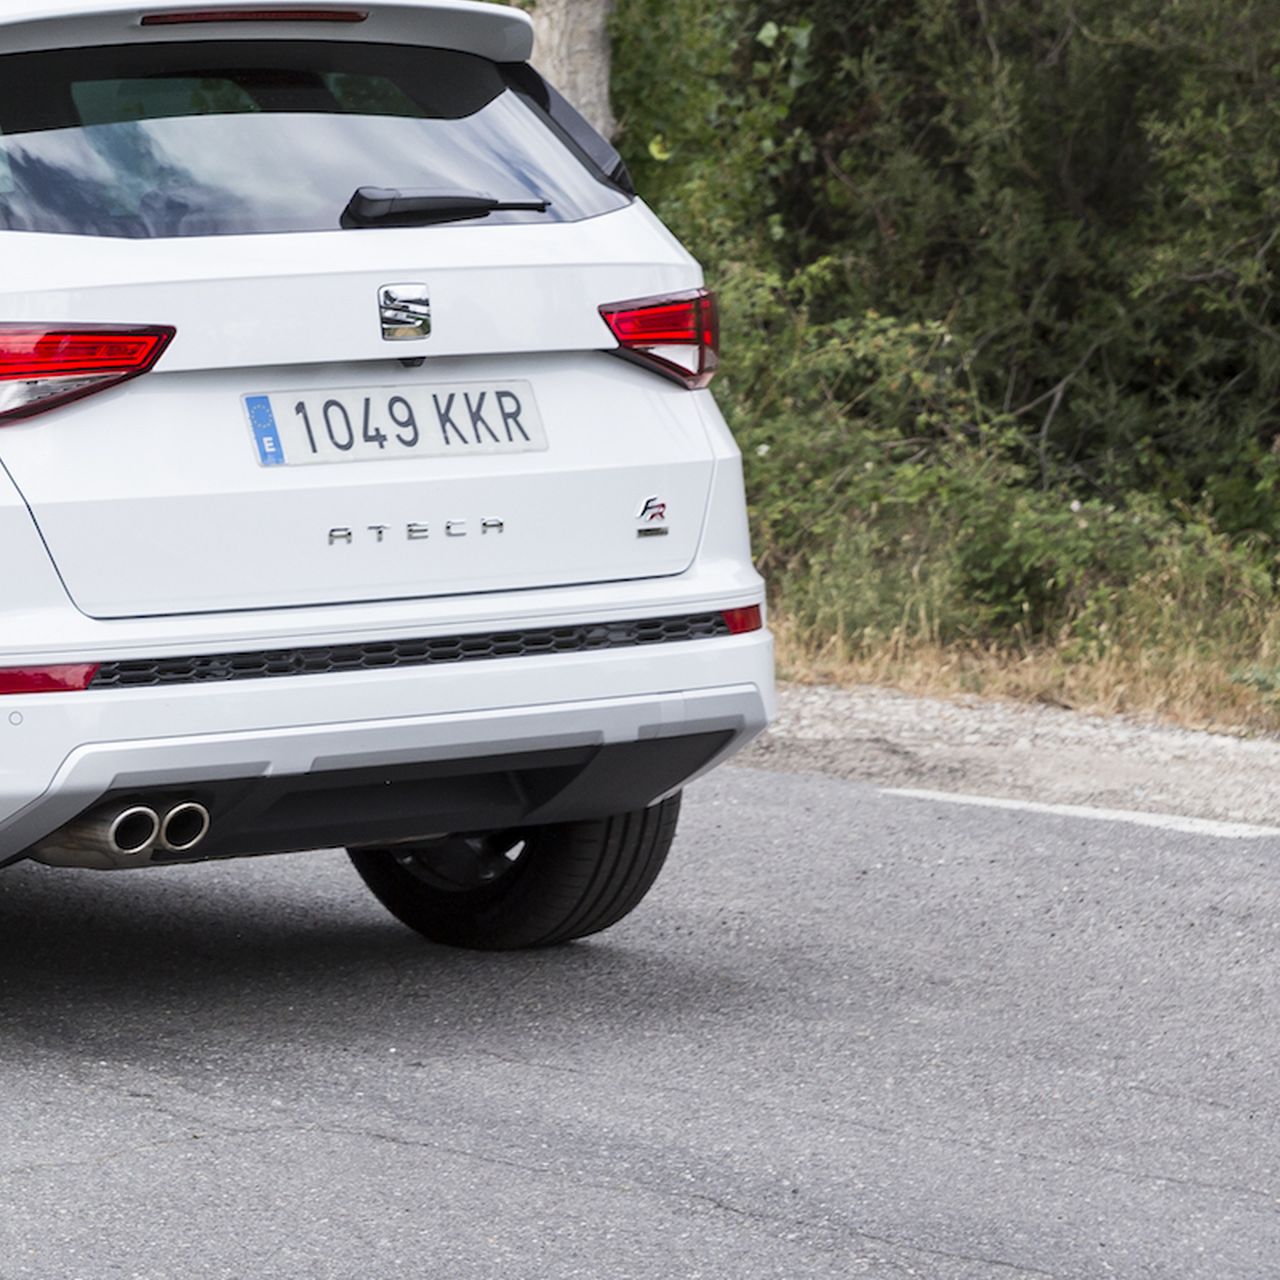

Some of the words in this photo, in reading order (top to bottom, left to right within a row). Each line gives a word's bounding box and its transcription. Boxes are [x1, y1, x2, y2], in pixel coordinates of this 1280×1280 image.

[294, 395, 420, 454] 1049
[431, 389, 532, 446] KKR
[262, 436, 276, 453] E
[327, 517, 505, 546] ATECA
